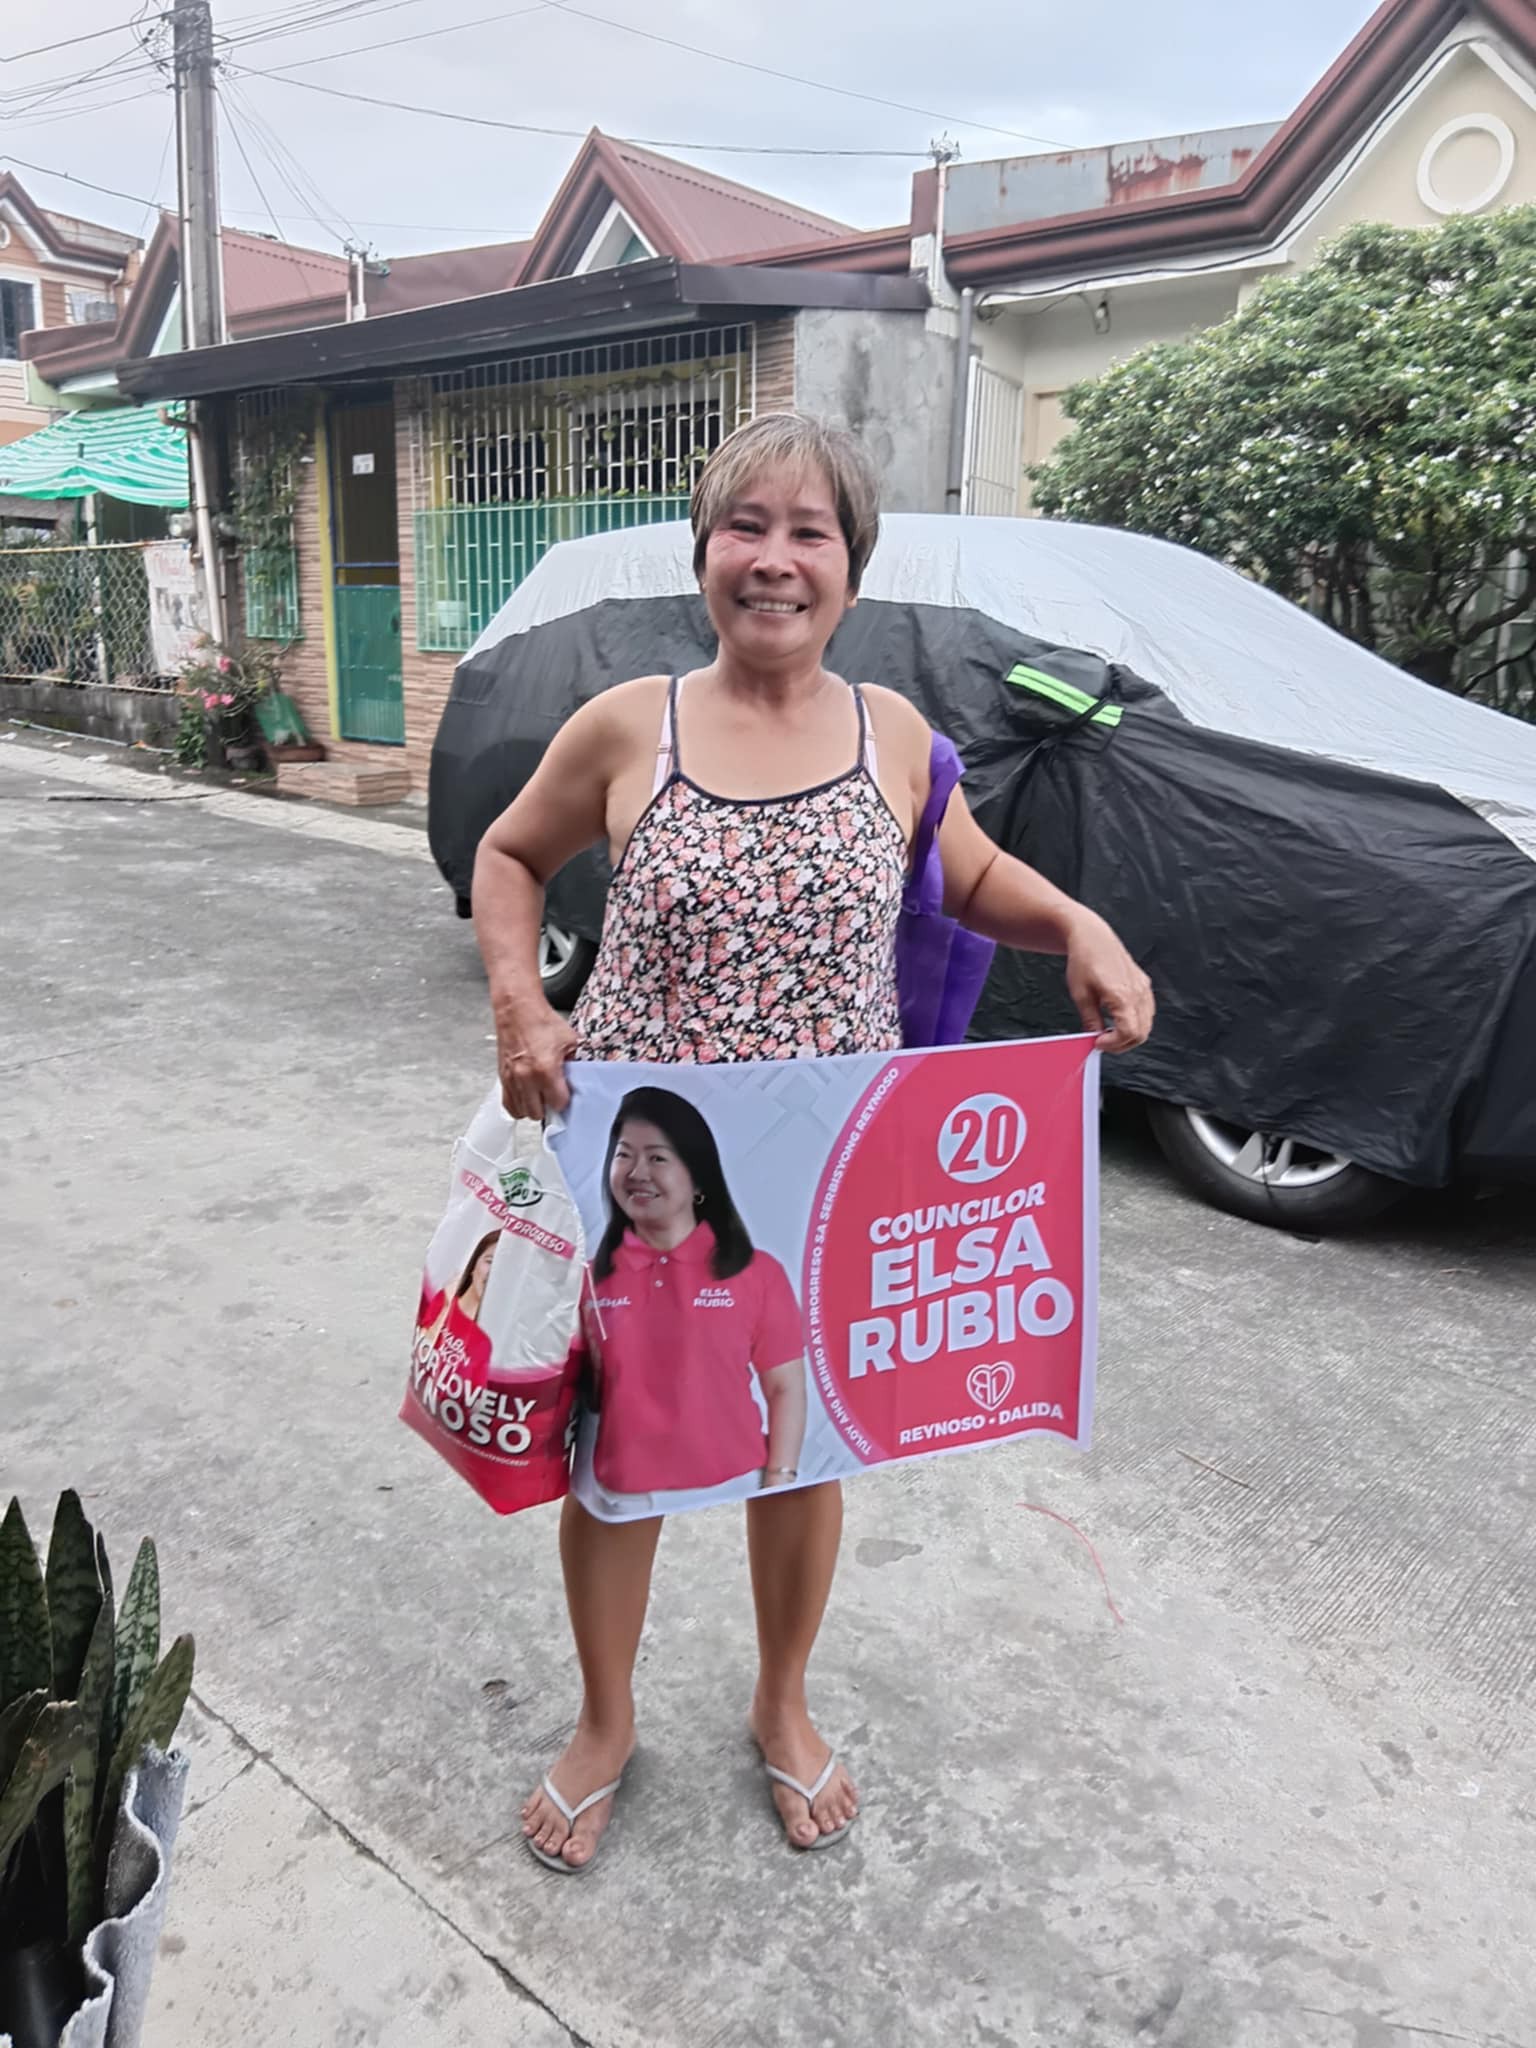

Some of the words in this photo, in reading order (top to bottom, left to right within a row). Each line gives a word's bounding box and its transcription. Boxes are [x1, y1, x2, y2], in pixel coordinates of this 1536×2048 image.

[855, 1067, 899, 1132] REYNOSO
[948, 1104, 1019, 1174] 20
[819, 1131, 861, 1222] SERBISYONG
[814, 1223, 829, 1244] SA
[868, 1181, 1046, 1245] COUNCILOR
[809, 1248, 823, 1326] PROGRESO
[871, 1213, 1053, 1310] ELSA
[692, 1297, 735, 1309] RUBIO
[699, 1287, 731, 1298] ELSA
[811, 1328, 823, 1346] AT
[849, 1276, 1075, 1380] RUBIO
[436, 1364, 538, 1423] LOVELY
[814, 1348, 837, 1399] ASENSO
[830, 1398, 849, 1424] ANG
[899, 1413, 986, 1444] REYNOSO
[998, 1401, 1064, 1426] DALIDA
[846, 1424, 873, 1456] TULOY
